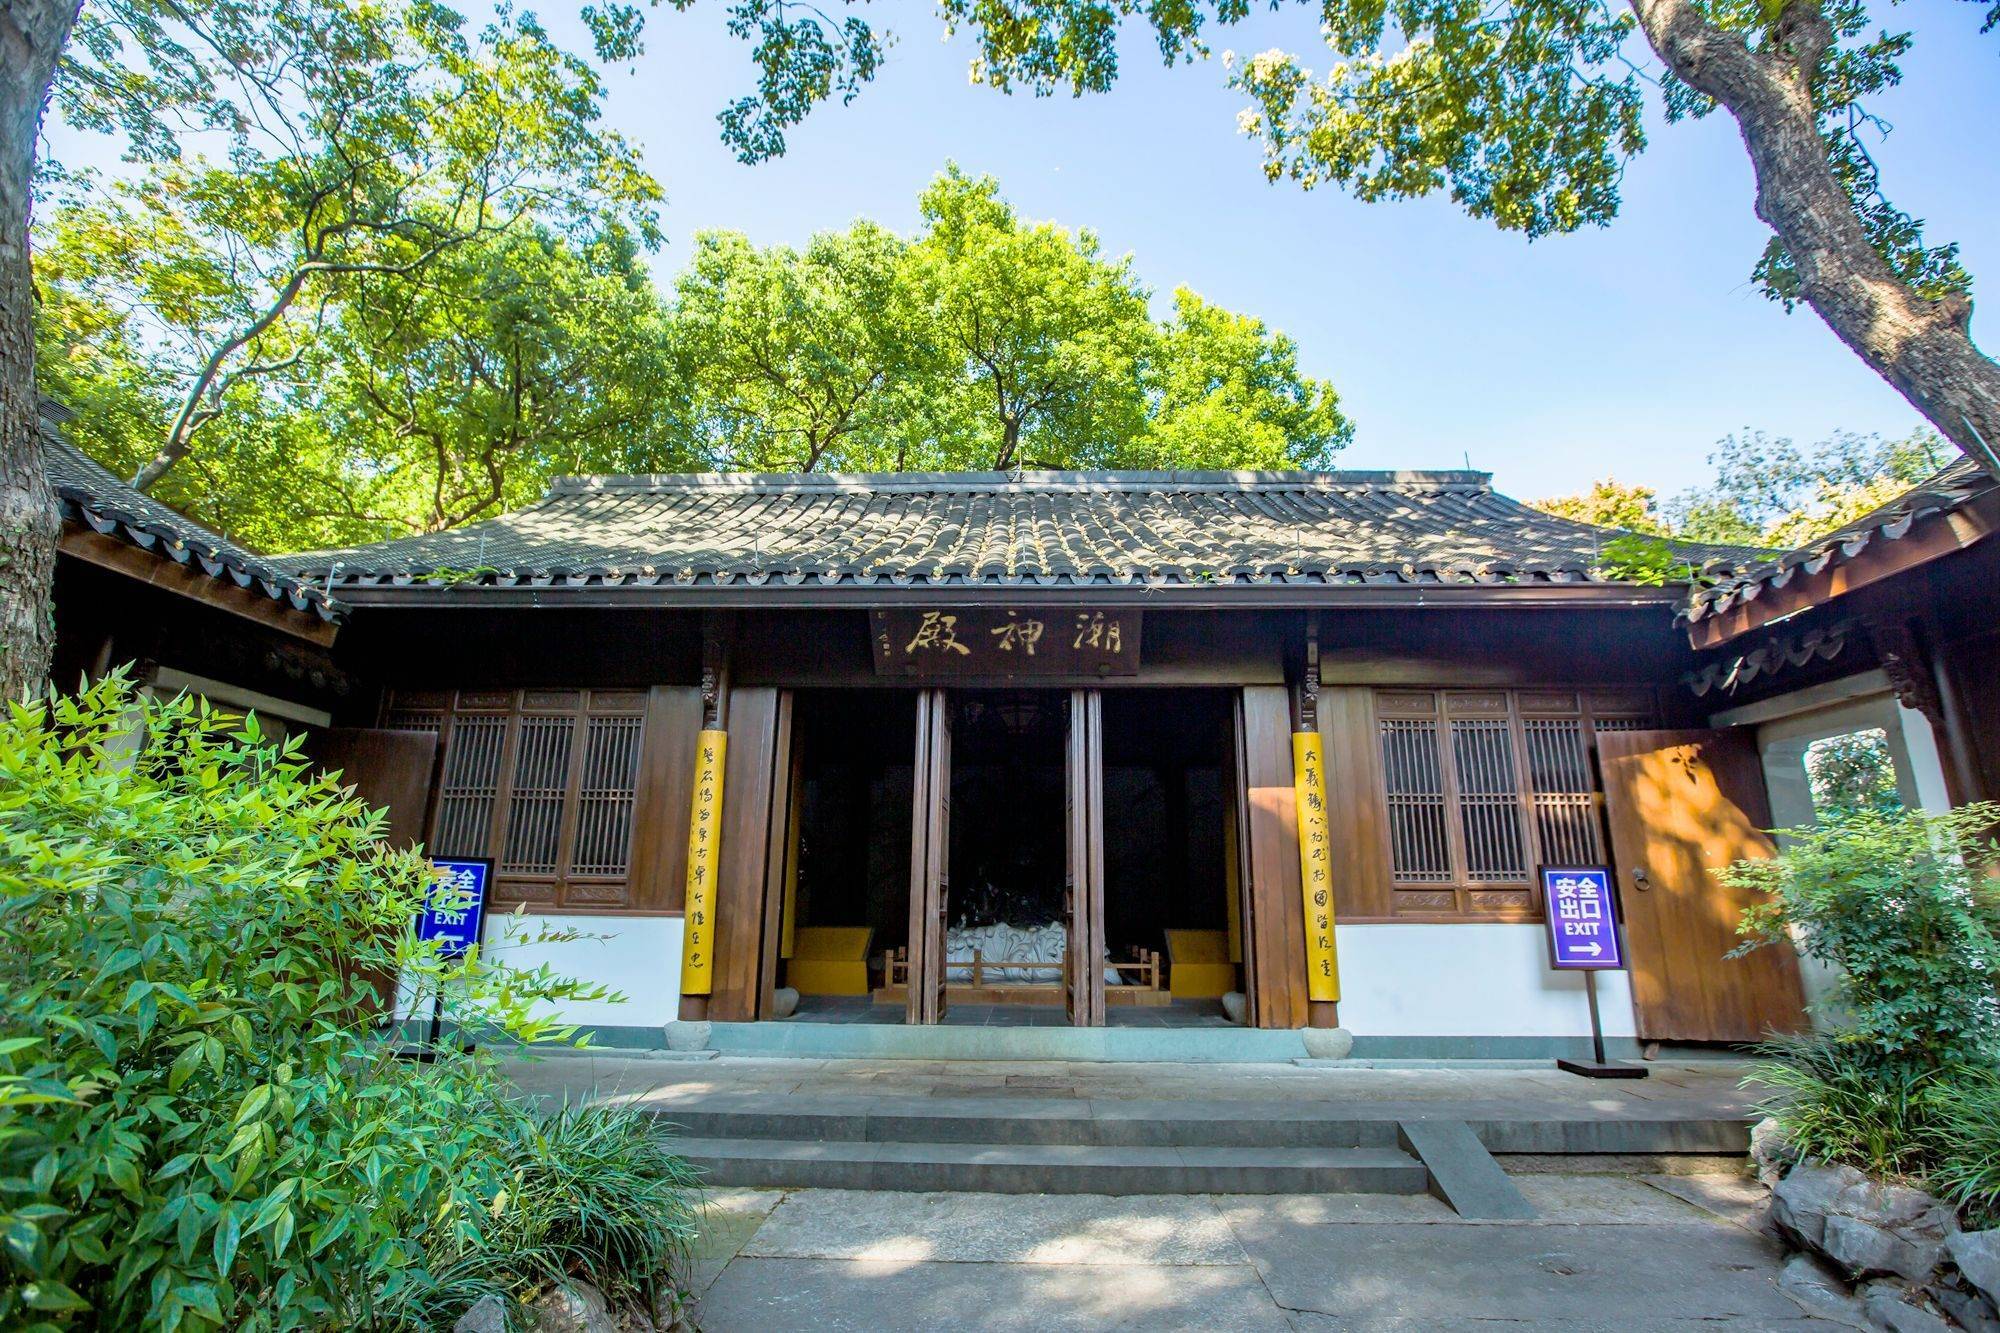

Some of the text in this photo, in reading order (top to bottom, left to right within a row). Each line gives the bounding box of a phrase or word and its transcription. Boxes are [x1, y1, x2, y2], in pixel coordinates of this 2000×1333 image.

[1555, 877, 1600, 899] 安全
[1559, 898, 1602, 919] 出口
[434, 911, 469, 926] EXIT
[1564, 922, 1600, 936] EXIT
